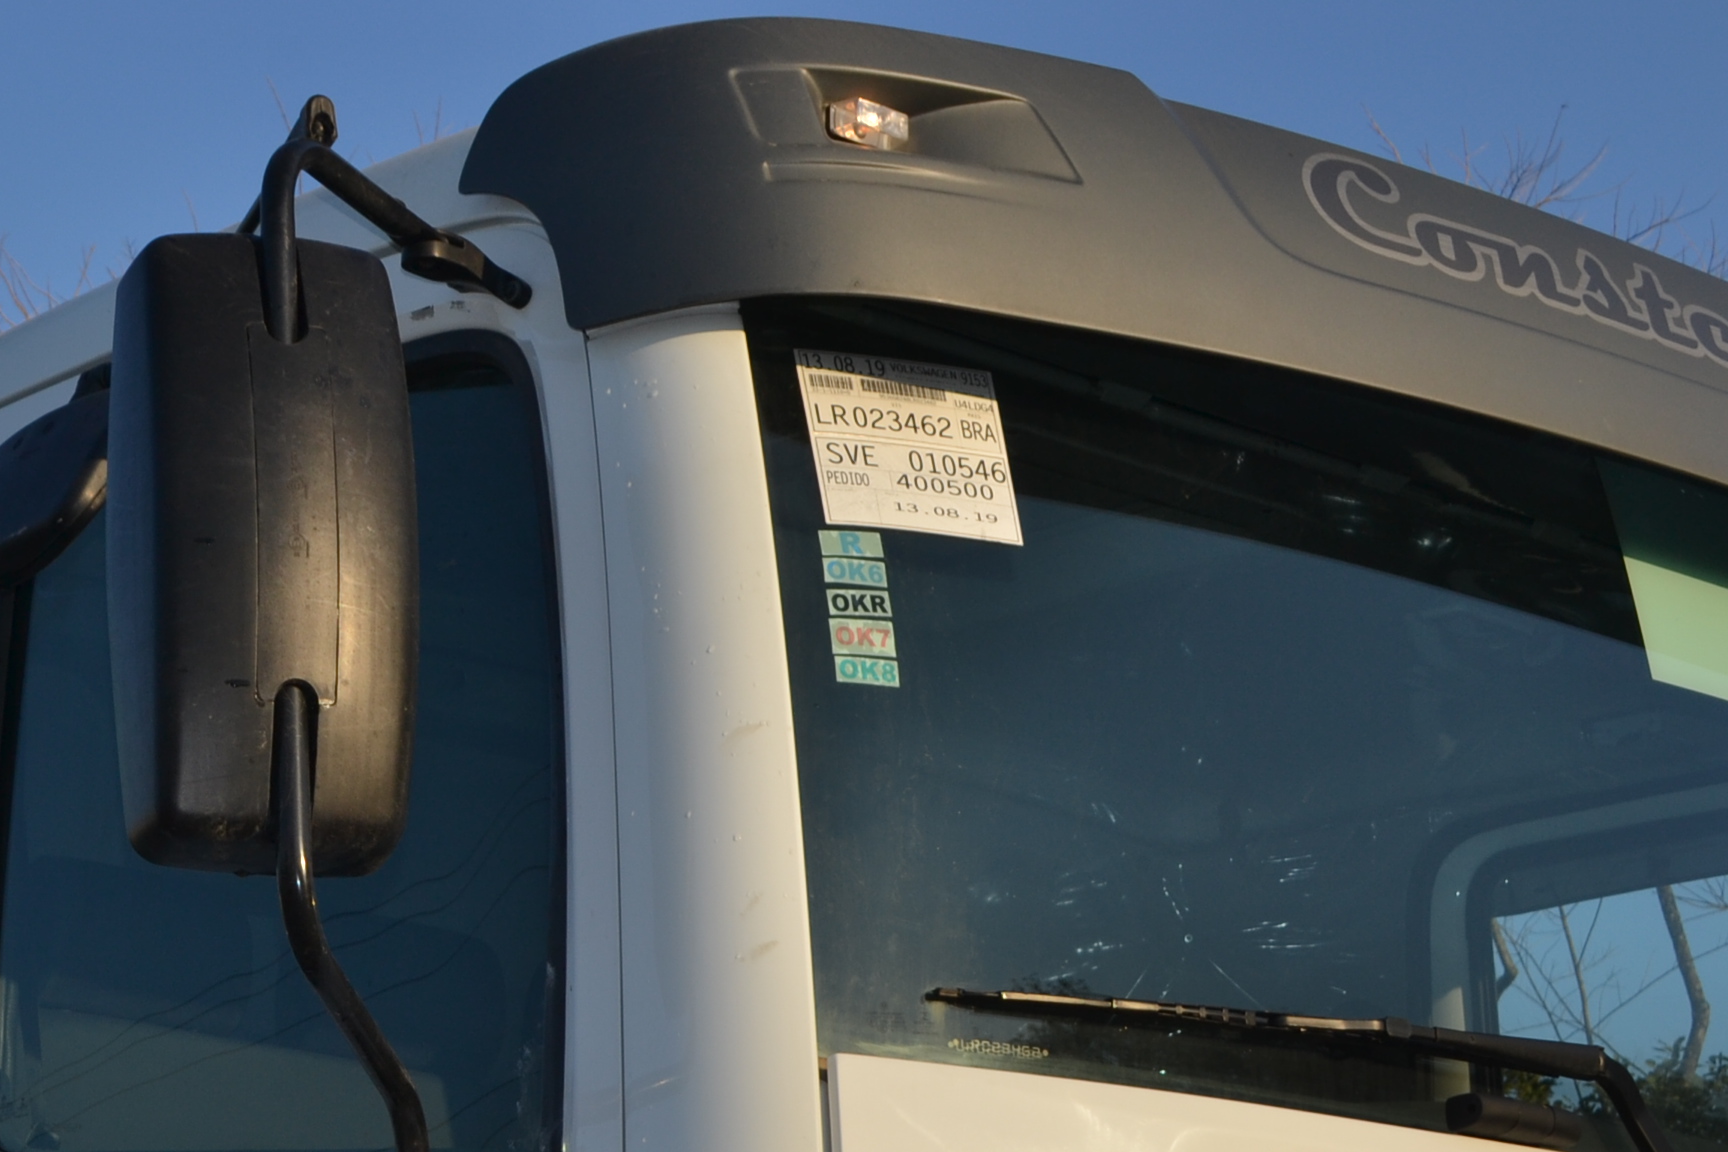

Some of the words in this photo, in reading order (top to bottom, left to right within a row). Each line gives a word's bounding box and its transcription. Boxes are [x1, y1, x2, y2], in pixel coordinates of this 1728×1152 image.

[889, 362, 957, 380] VOLKSWAGEN
[814, 403, 953, 439] LR023462
[960, 419, 997, 443] BRA
[826, 442, 879, 467] SVE
[908, 450, 1006, 483] 010546
[826, 471, 870, 486] PEDIDO
[896, 474, 994, 501] 400500
[894, 502, 998, 523] 13.08.19
[826, 560, 883, 584] OK6
[831, 593, 889, 614] OKR
[835, 626, 891, 648] OK7
[839, 658, 897, 683] OK8
